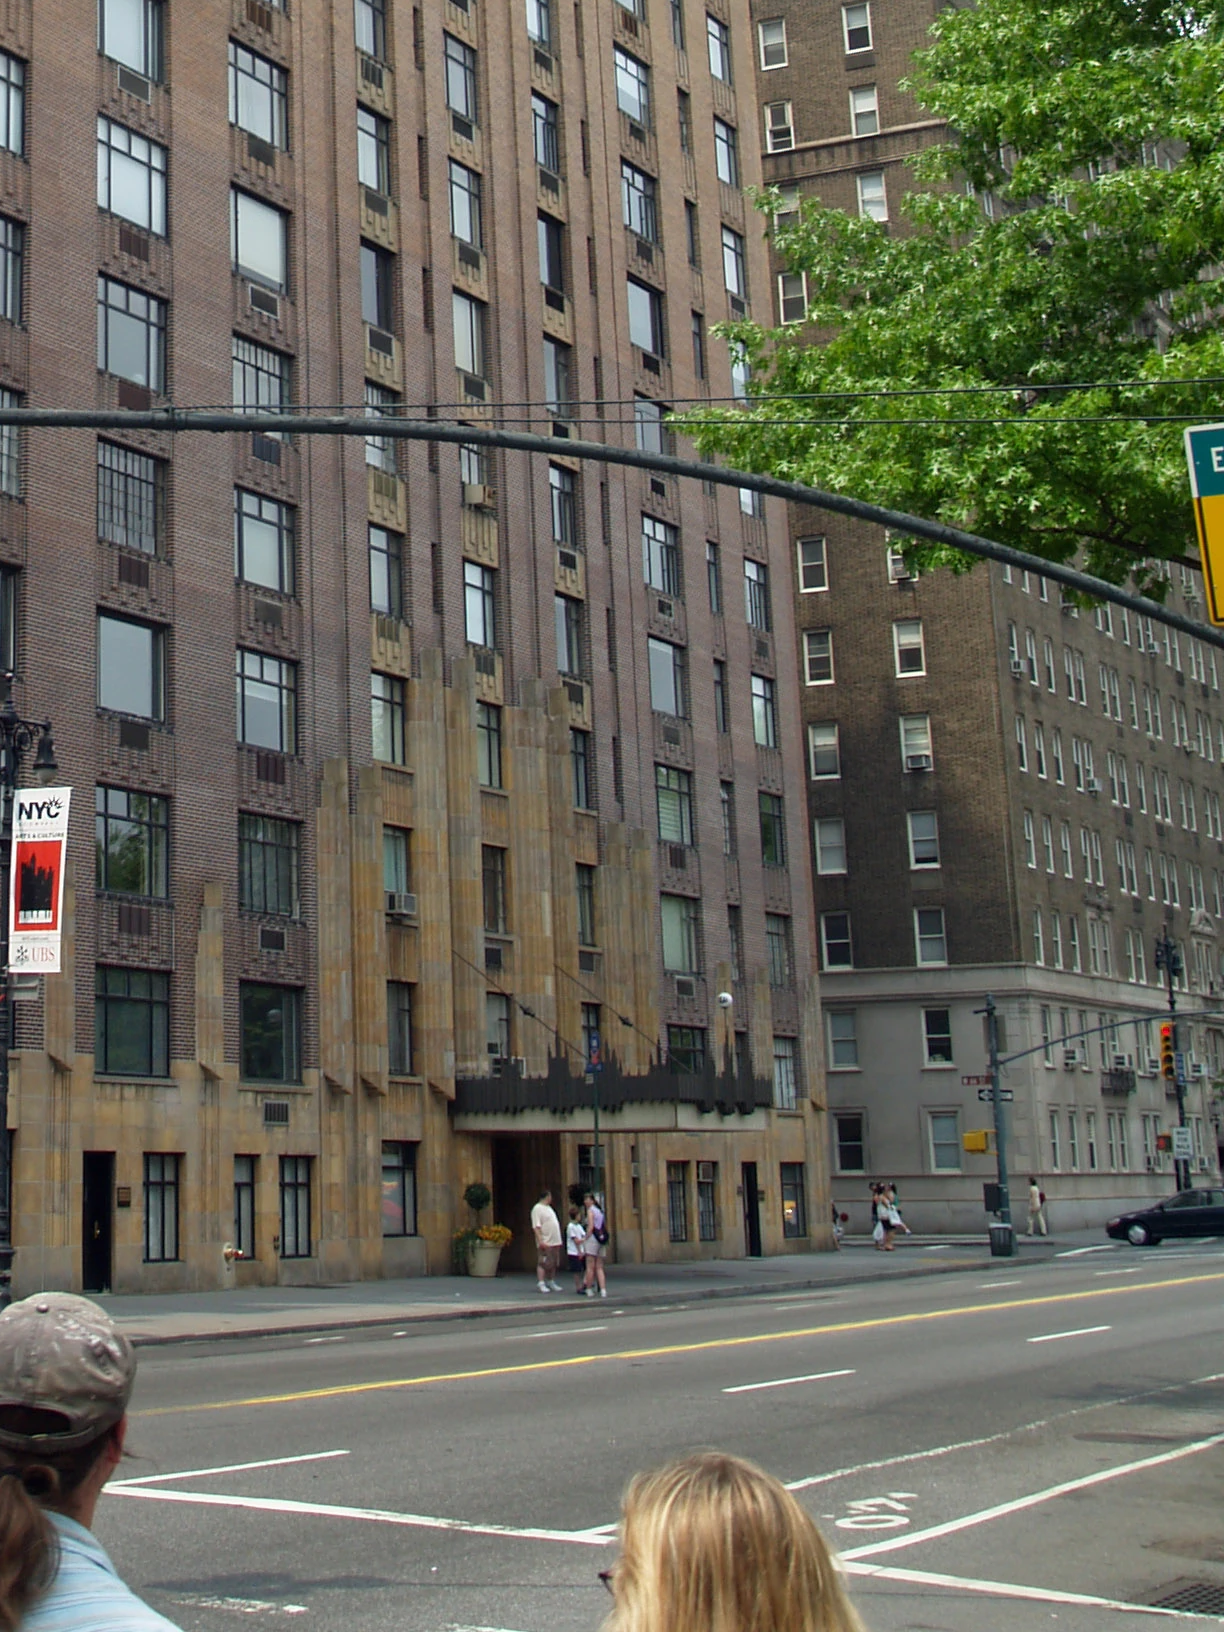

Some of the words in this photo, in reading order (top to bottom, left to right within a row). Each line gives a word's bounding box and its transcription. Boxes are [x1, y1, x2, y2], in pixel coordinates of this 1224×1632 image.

[18, 797, 62, 820] NYC
[37, 831, 65, 839] CULTURE
[32, 947, 55, 962] UBS
